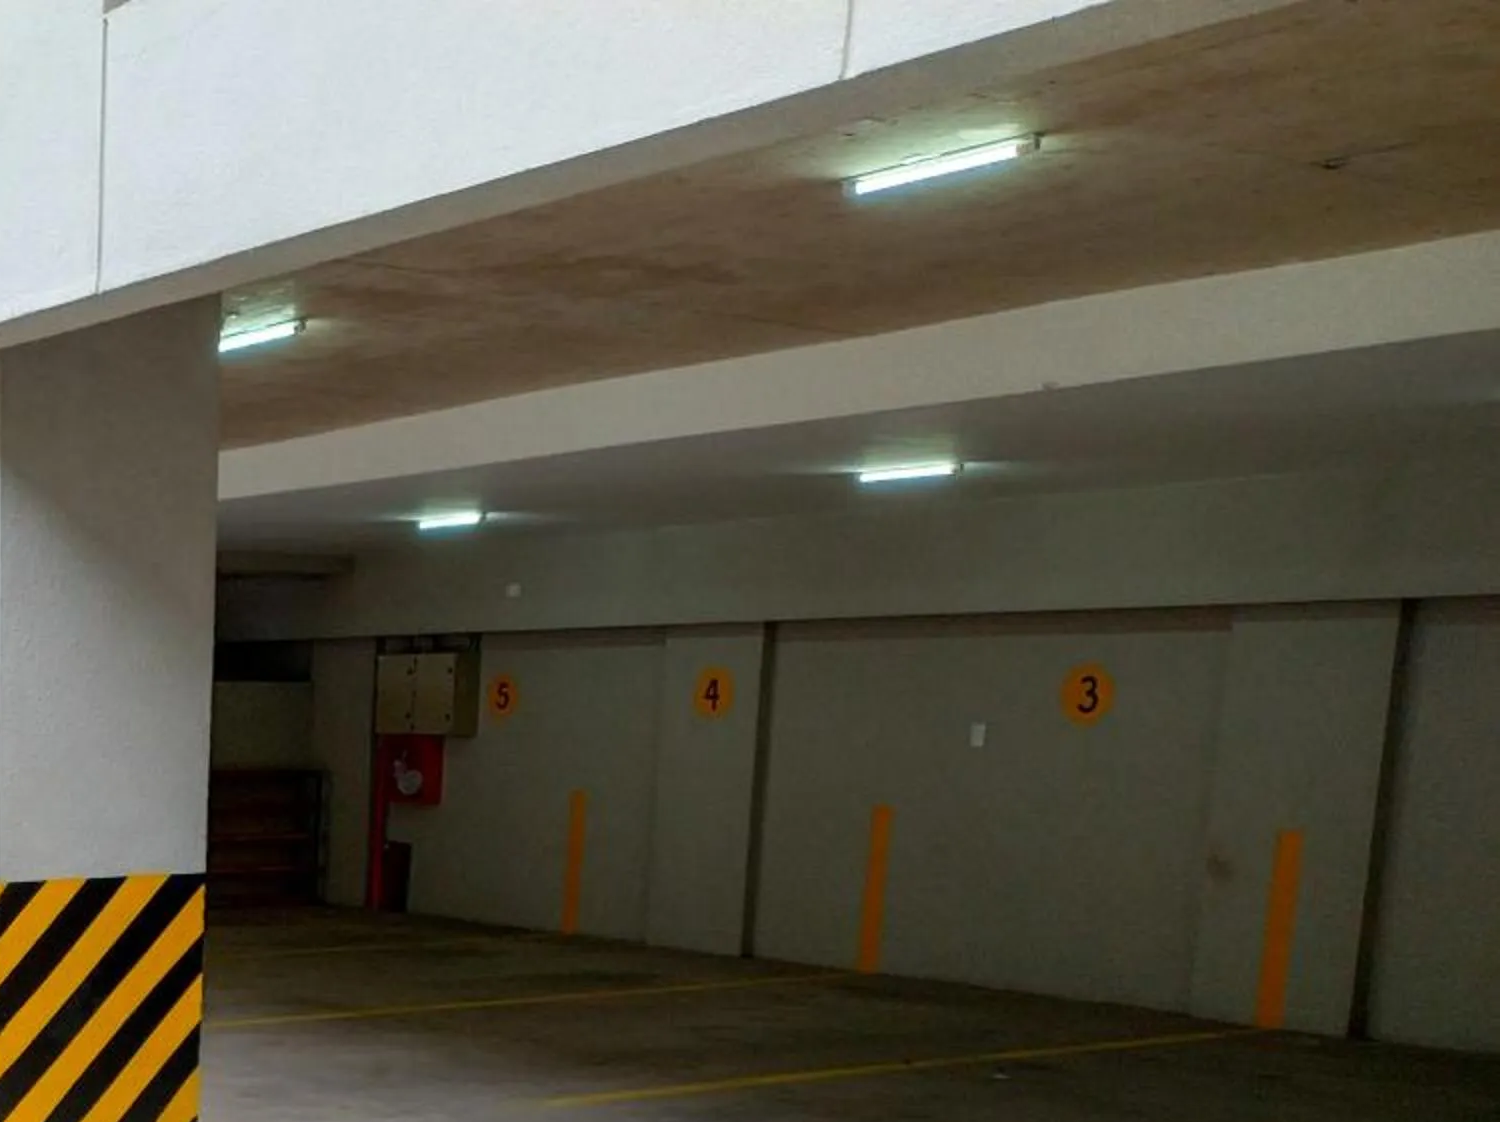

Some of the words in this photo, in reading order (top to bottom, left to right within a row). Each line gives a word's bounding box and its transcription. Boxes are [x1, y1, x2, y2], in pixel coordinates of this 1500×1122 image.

[496, 682, 510, 710] 5
[703, 679, 719, 711] 4
[1077, 676, 1098, 714] 3
